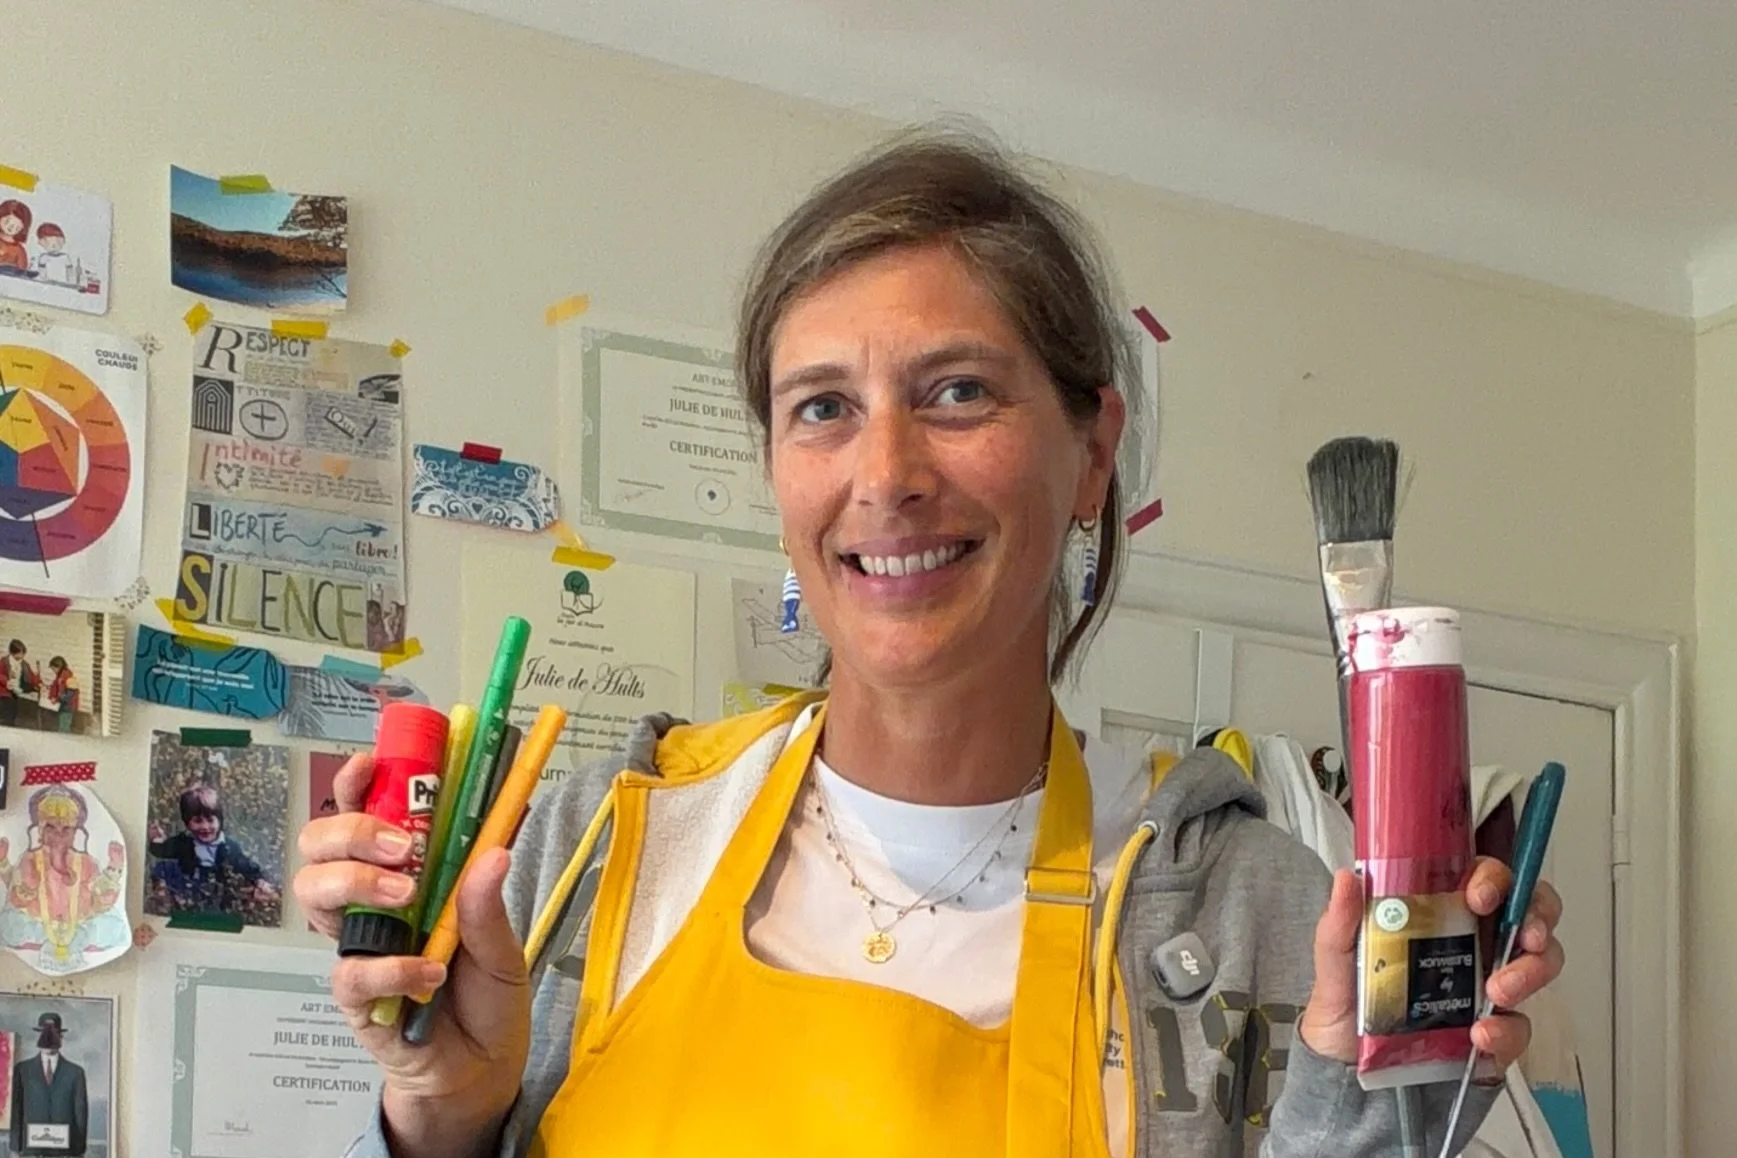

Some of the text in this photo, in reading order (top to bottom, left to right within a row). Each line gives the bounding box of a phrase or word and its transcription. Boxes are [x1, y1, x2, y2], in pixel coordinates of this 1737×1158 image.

[669, 398, 700, 414] JULIE
[702, 404, 719, 417] DE
[669, 440, 758, 464] CERTIFICATION
[516, 655, 564, 691] Julie
[567, 667, 588, 690] de
[301, 1002, 321, 1013] ART
[273, 1031, 308, 1046] JULIE
[311, 1034, 329, 1047] DE
[272, 1075, 371, 1093] CERTIFICATION
